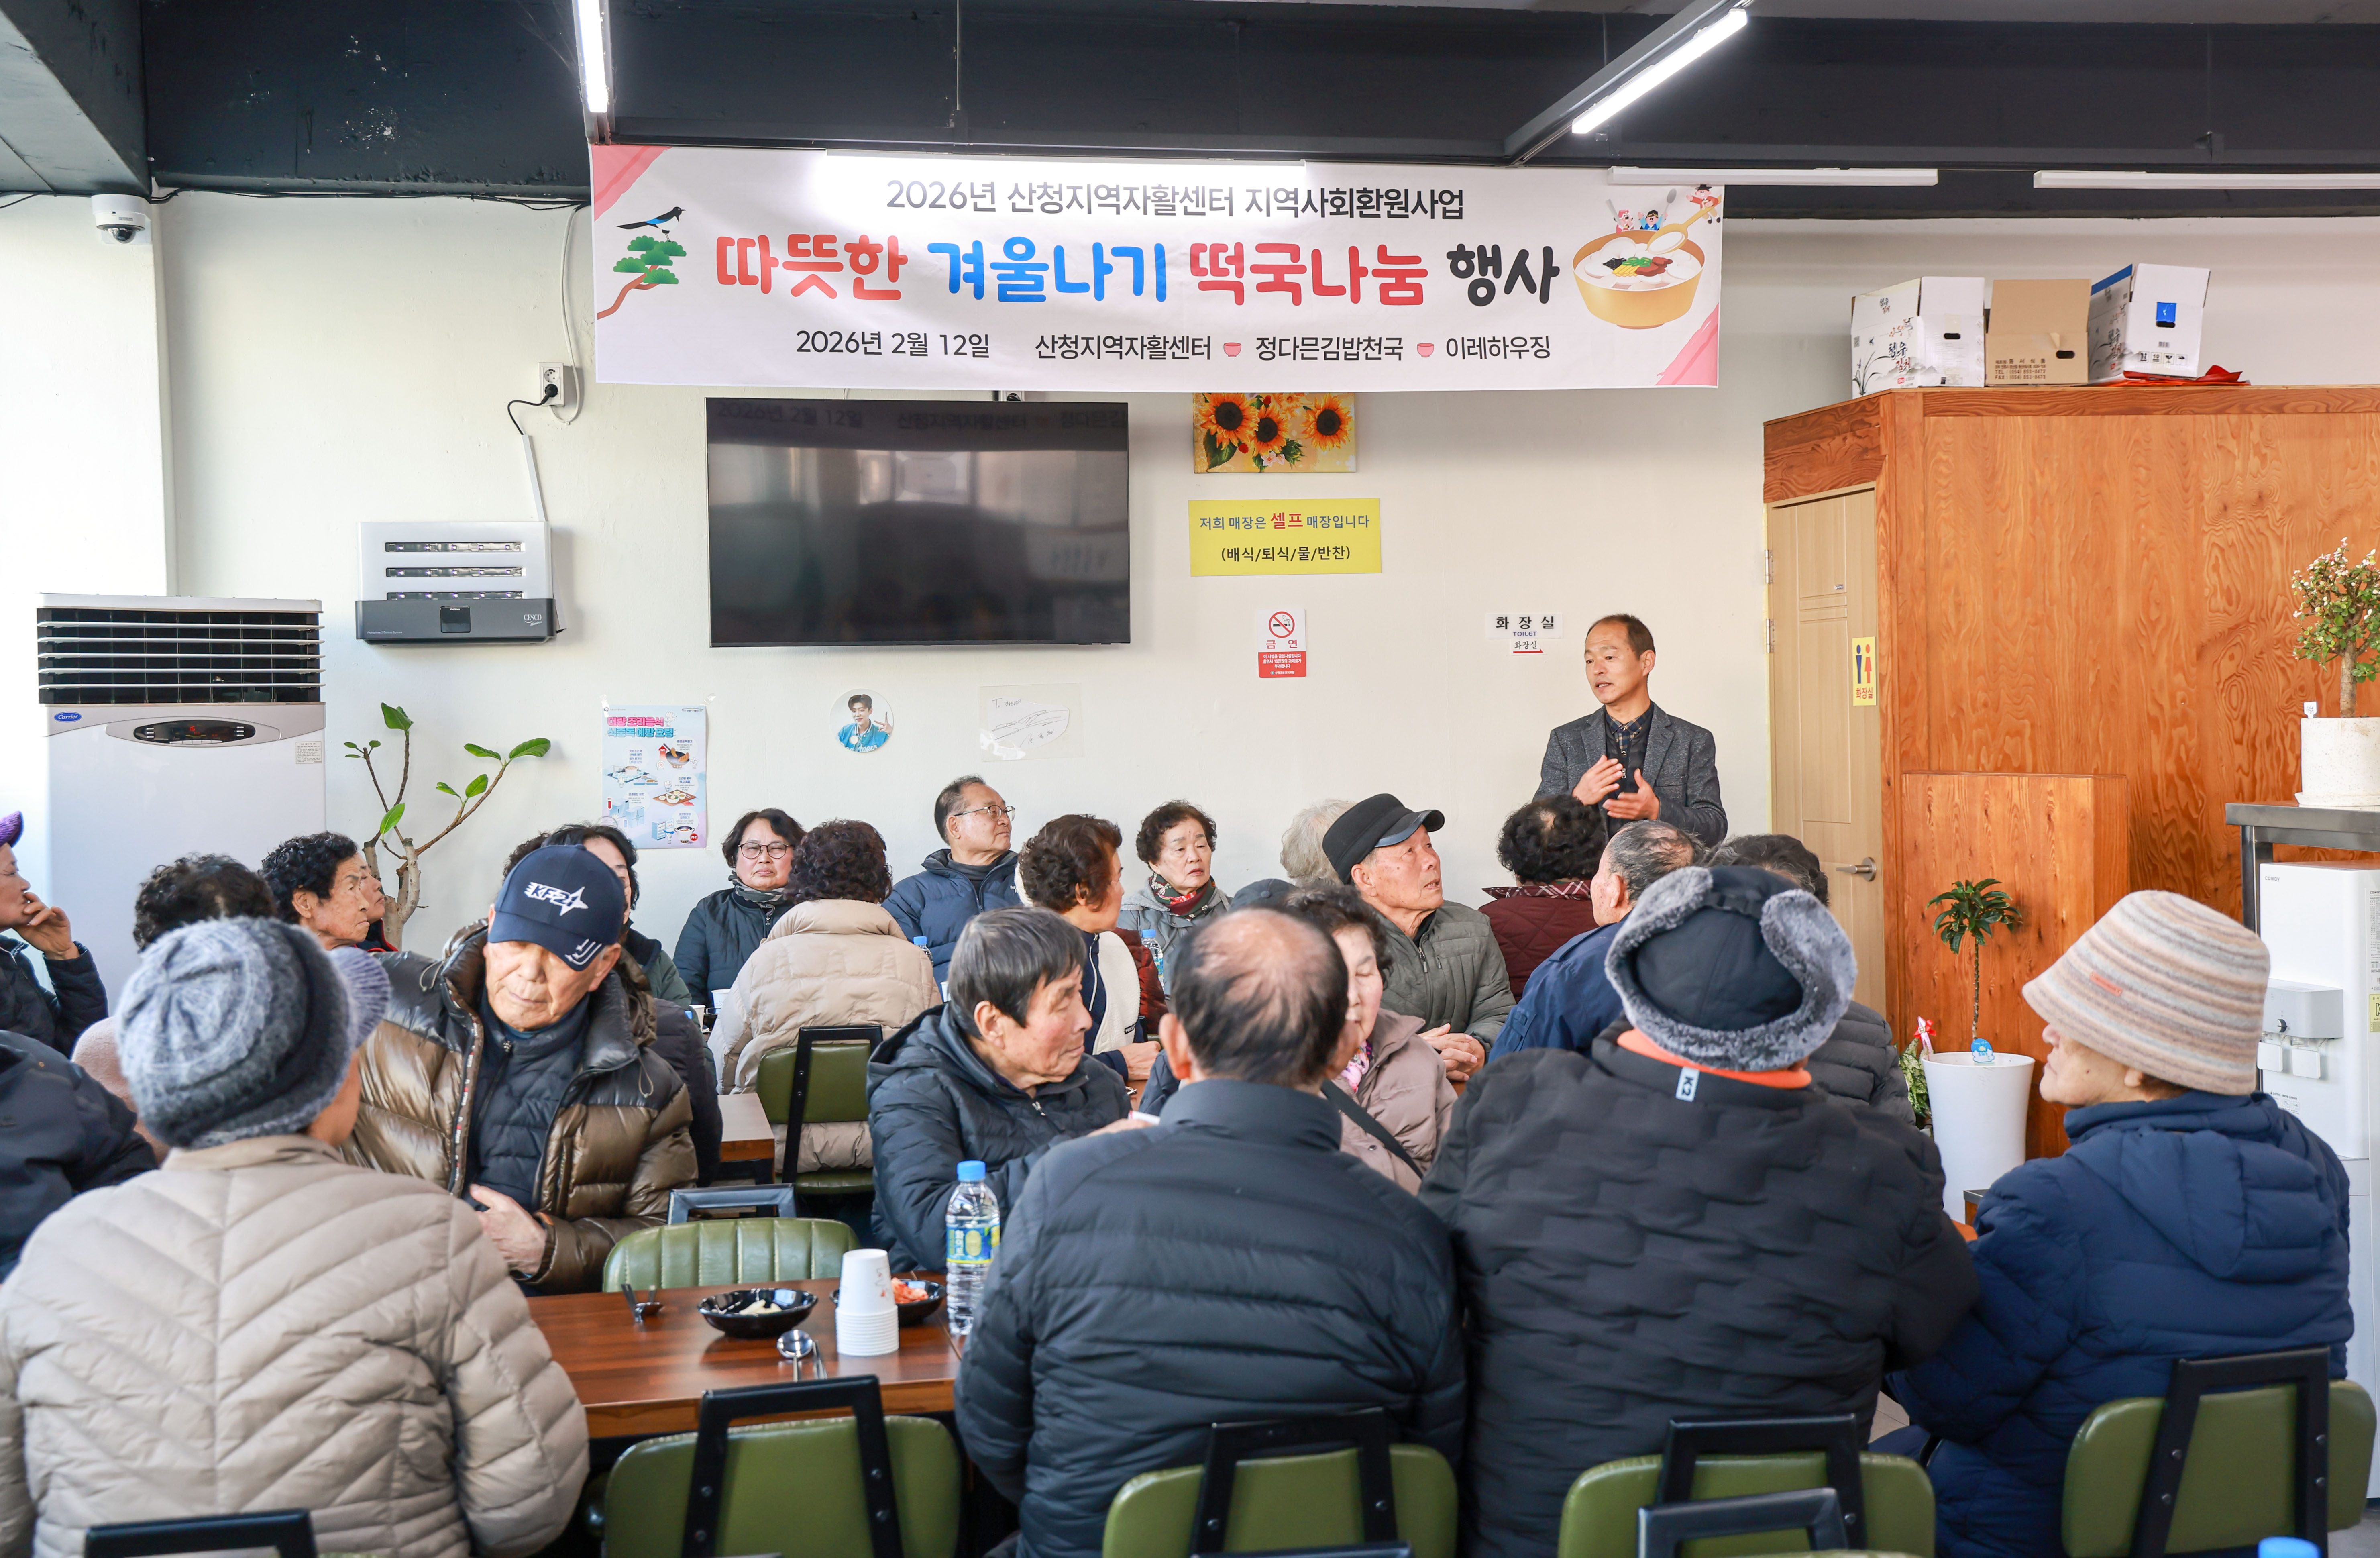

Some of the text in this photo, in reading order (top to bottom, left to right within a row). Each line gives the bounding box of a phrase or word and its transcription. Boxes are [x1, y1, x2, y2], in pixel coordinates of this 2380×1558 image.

[887, 180, 1463, 220] 2026년 산청지역자활센터 지역사회환원사업
[717, 234, 1561, 307] 따뜻한 겨울나기 떡국나눔 행사
[797, 330, 1551, 361] 2026년 2월 12일 산청지역자활센터 정다믄김밥천국 이레하우징
[1888, 342, 1907, 359] 청우
[1896, 357, 1911, 371] 김치
[1200, 512, 1369, 530] 저희 매장은 셀프 매장입니다
[1221, 546, 1351, 562] (배식/퇴식/물/반찬)
[1496, 616, 1554, 630] 화장실
[1514, 640, 1537, 649] 화장실
[1856, 687, 1873, 699] 화장실
[607, 716, 664, 726] 대량 조리음식
[607, 727, 674, 737] 식중독 예방 요령
